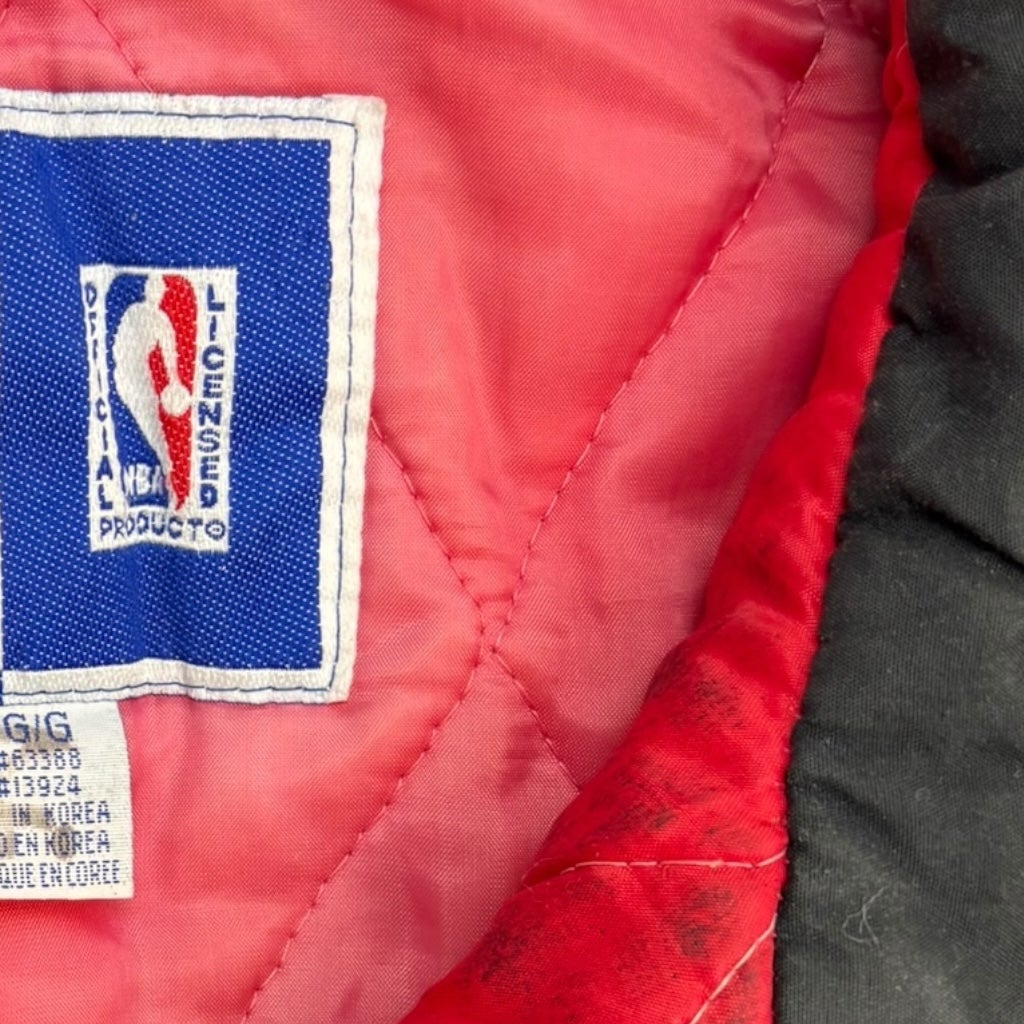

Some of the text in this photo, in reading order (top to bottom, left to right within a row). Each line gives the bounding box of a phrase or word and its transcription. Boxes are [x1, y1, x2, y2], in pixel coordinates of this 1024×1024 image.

[196, 283, 226, 509] LICENSED
[123, 462, 165, 497] NBA
[11, 803, 31, 826] IN
[43, 800, 111, 826] KOREA
[13, 833, 38, 856] EN
[43, 829, 111, 857] KOREA
[39, 862, 63, 887] EN
[65, 859, 121, 887] COREE
